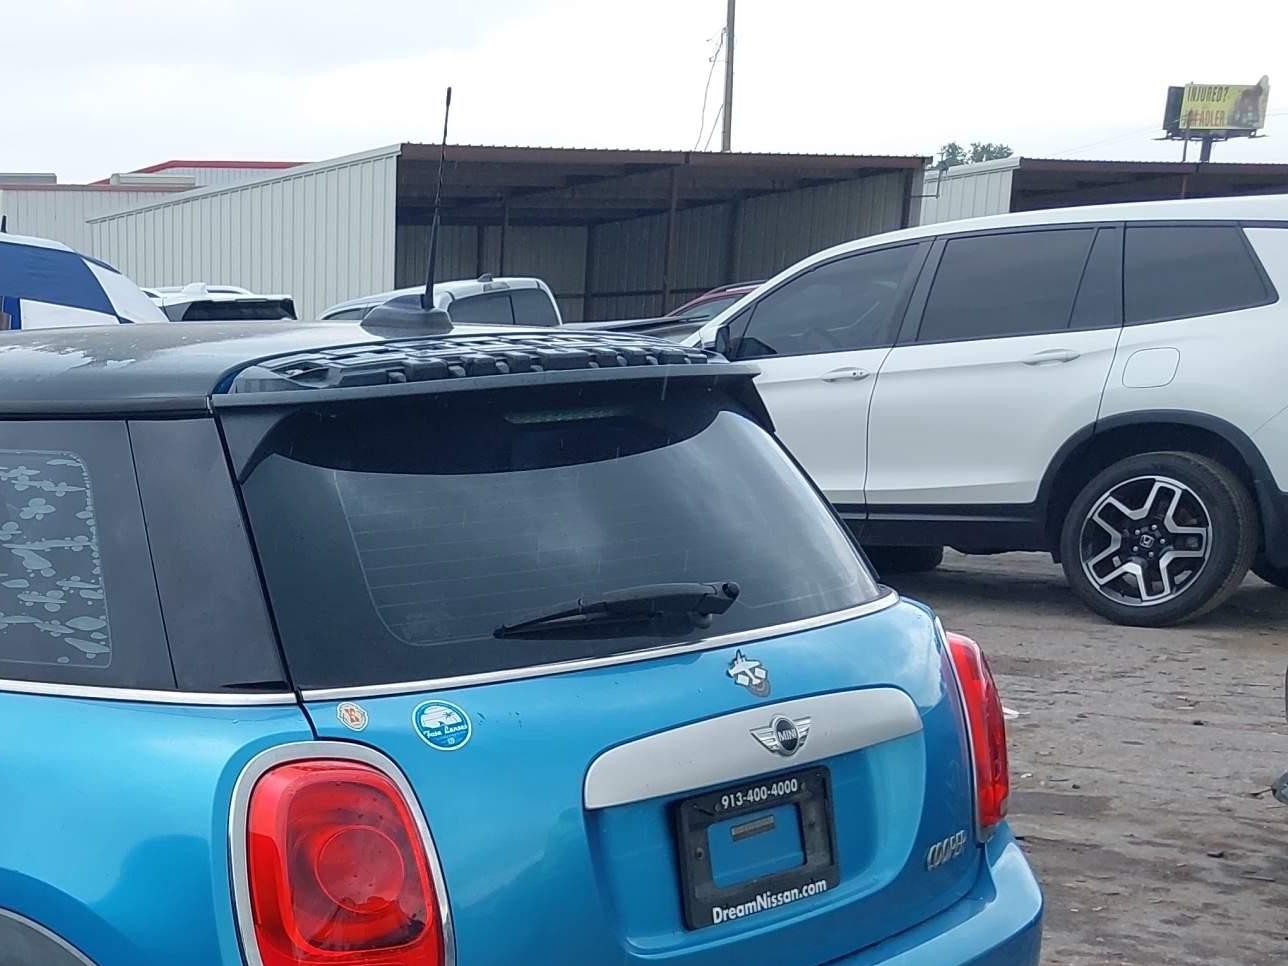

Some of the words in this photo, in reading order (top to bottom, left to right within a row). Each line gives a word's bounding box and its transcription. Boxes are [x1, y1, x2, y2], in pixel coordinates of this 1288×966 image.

[777, 728, 797, 743] MINI
[721, 778, 798, 809] 913-400-4000
[712, 879, 827, 924] DreamNissan.com
